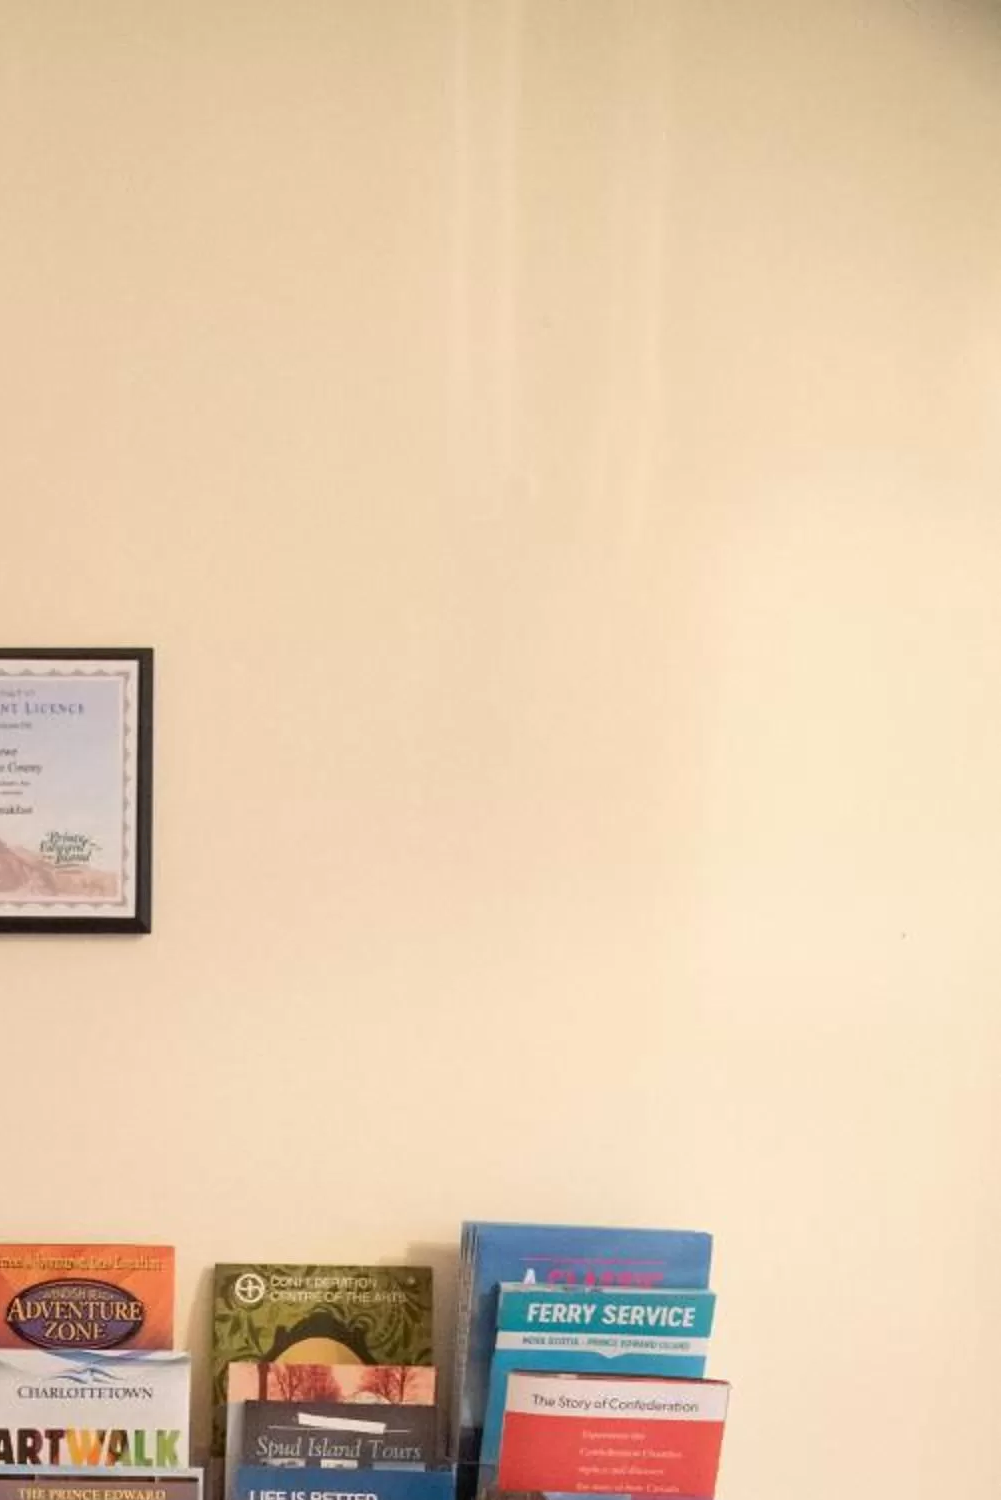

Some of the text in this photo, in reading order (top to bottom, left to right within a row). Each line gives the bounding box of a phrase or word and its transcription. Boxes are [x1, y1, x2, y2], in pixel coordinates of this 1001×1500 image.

[24, 702, 86, 716] LICENCE
[269, 1291, 406, 1304] CENTRE OF THE ARTS
[7, 1298, 144, 1322] ADVENTURE
[527, 1303, 696, 1328] FERRY SERVICE
[44, 1321, 107, 1341] ZONE
[17, 1386, 154, 1399] CHARLOTTETOWN
[532, 1394, 699, 1413] The Story of Confederation
[255, 1436, 422, 1461] Spud Island Tours
[18, 1488, 166, 1500] THE PRINCE EDWARD
